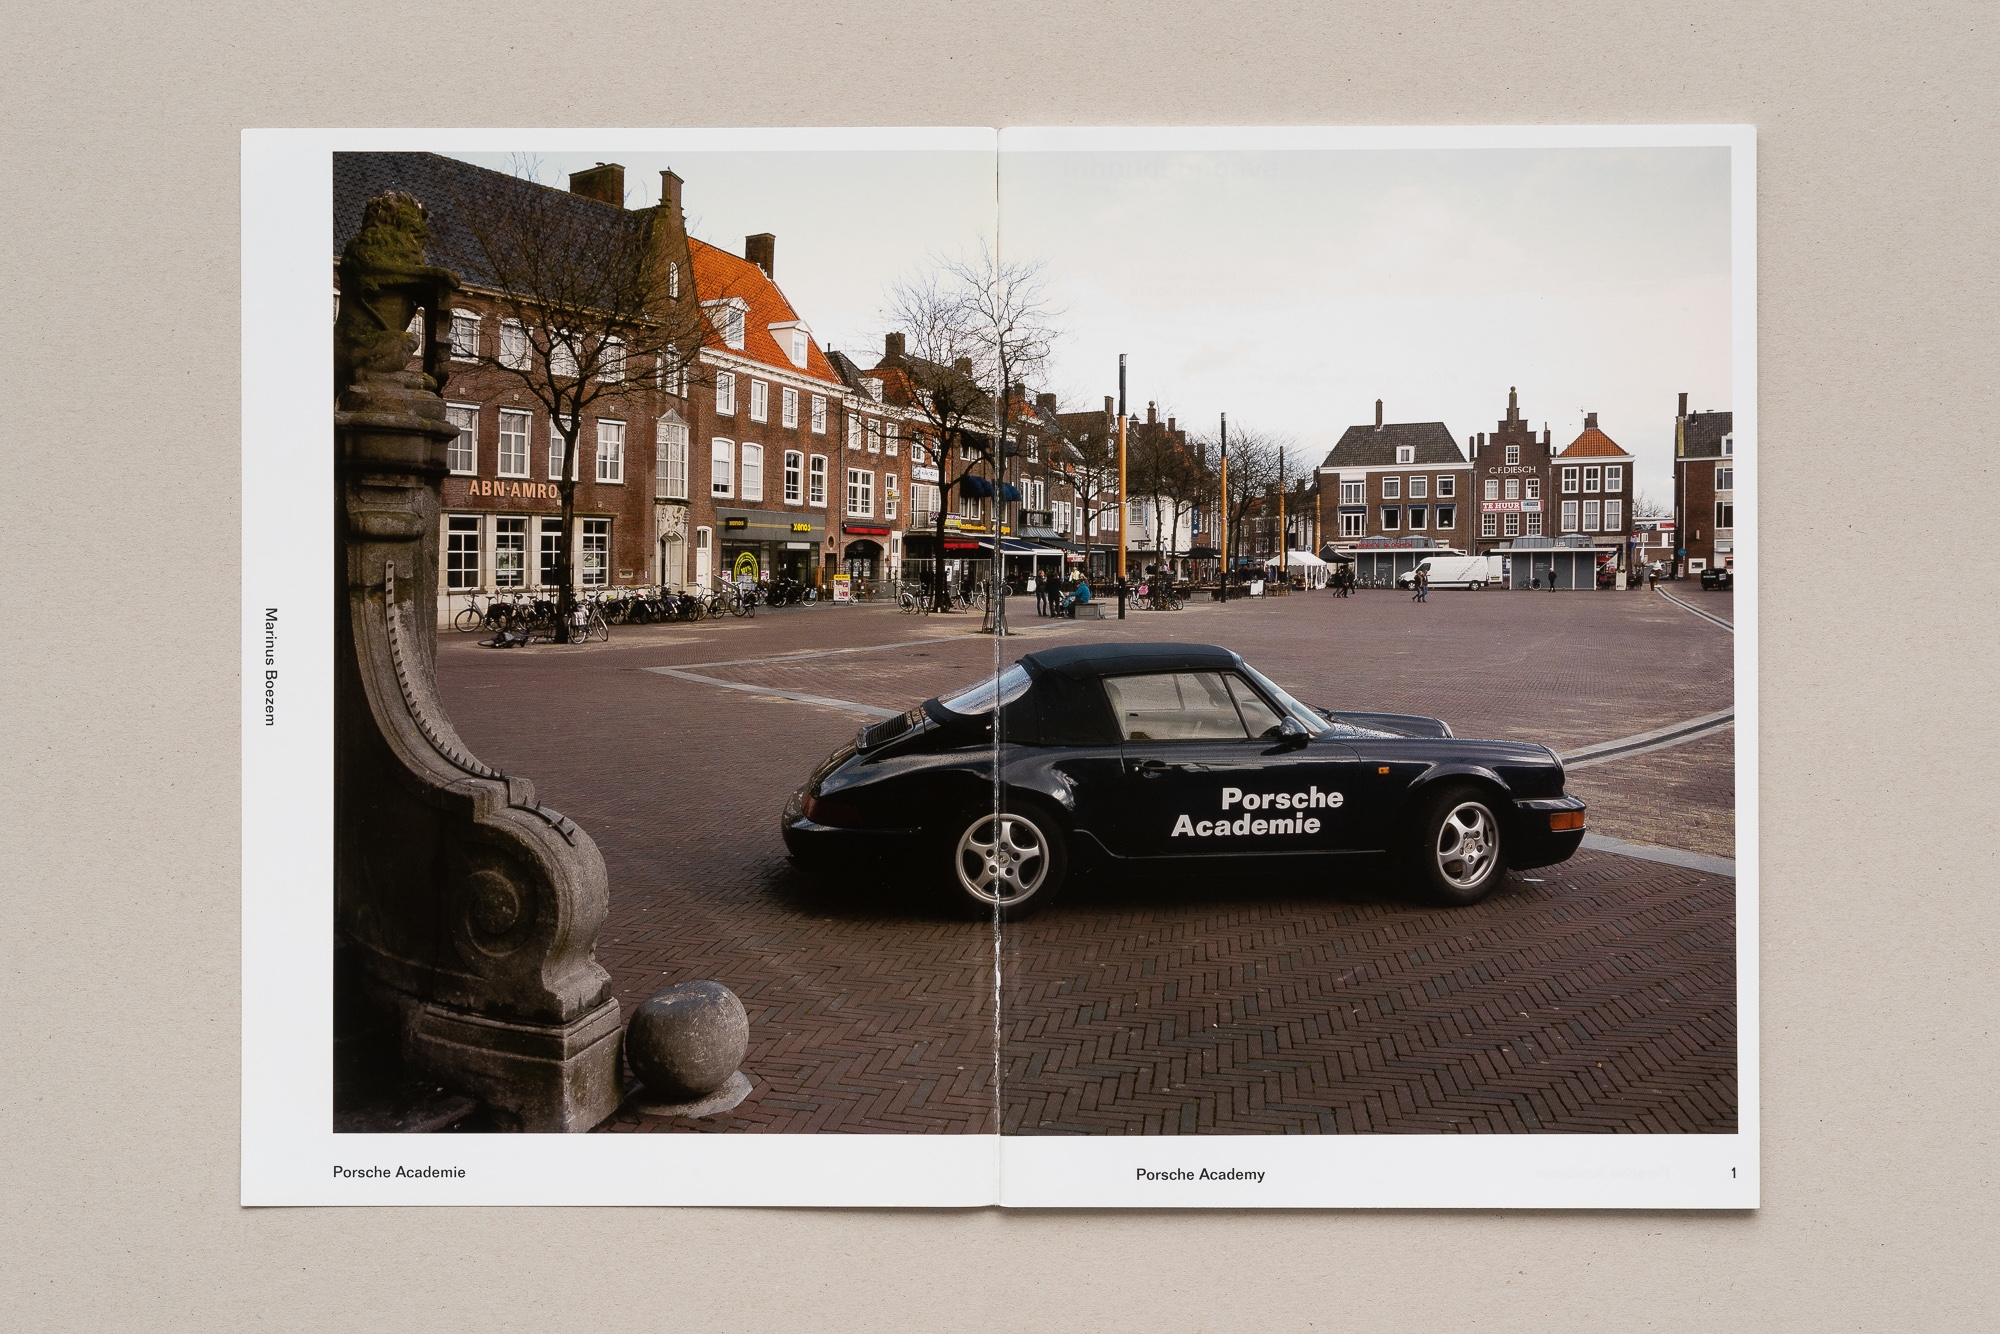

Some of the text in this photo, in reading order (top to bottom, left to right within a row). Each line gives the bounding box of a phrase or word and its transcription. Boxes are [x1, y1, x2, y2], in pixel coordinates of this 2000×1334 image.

[265, 608, 278, 726] Marinus Boezem
[1222, 786, 1344, 810] Porsche
[1171, 812, 1321, 837] Academie
[333, 1165, 466, 1178] Porsche Academie
[1136, 1167, 1265, 1183] Porsche Academy
[1731, 1166, 1737, 1179] 1
